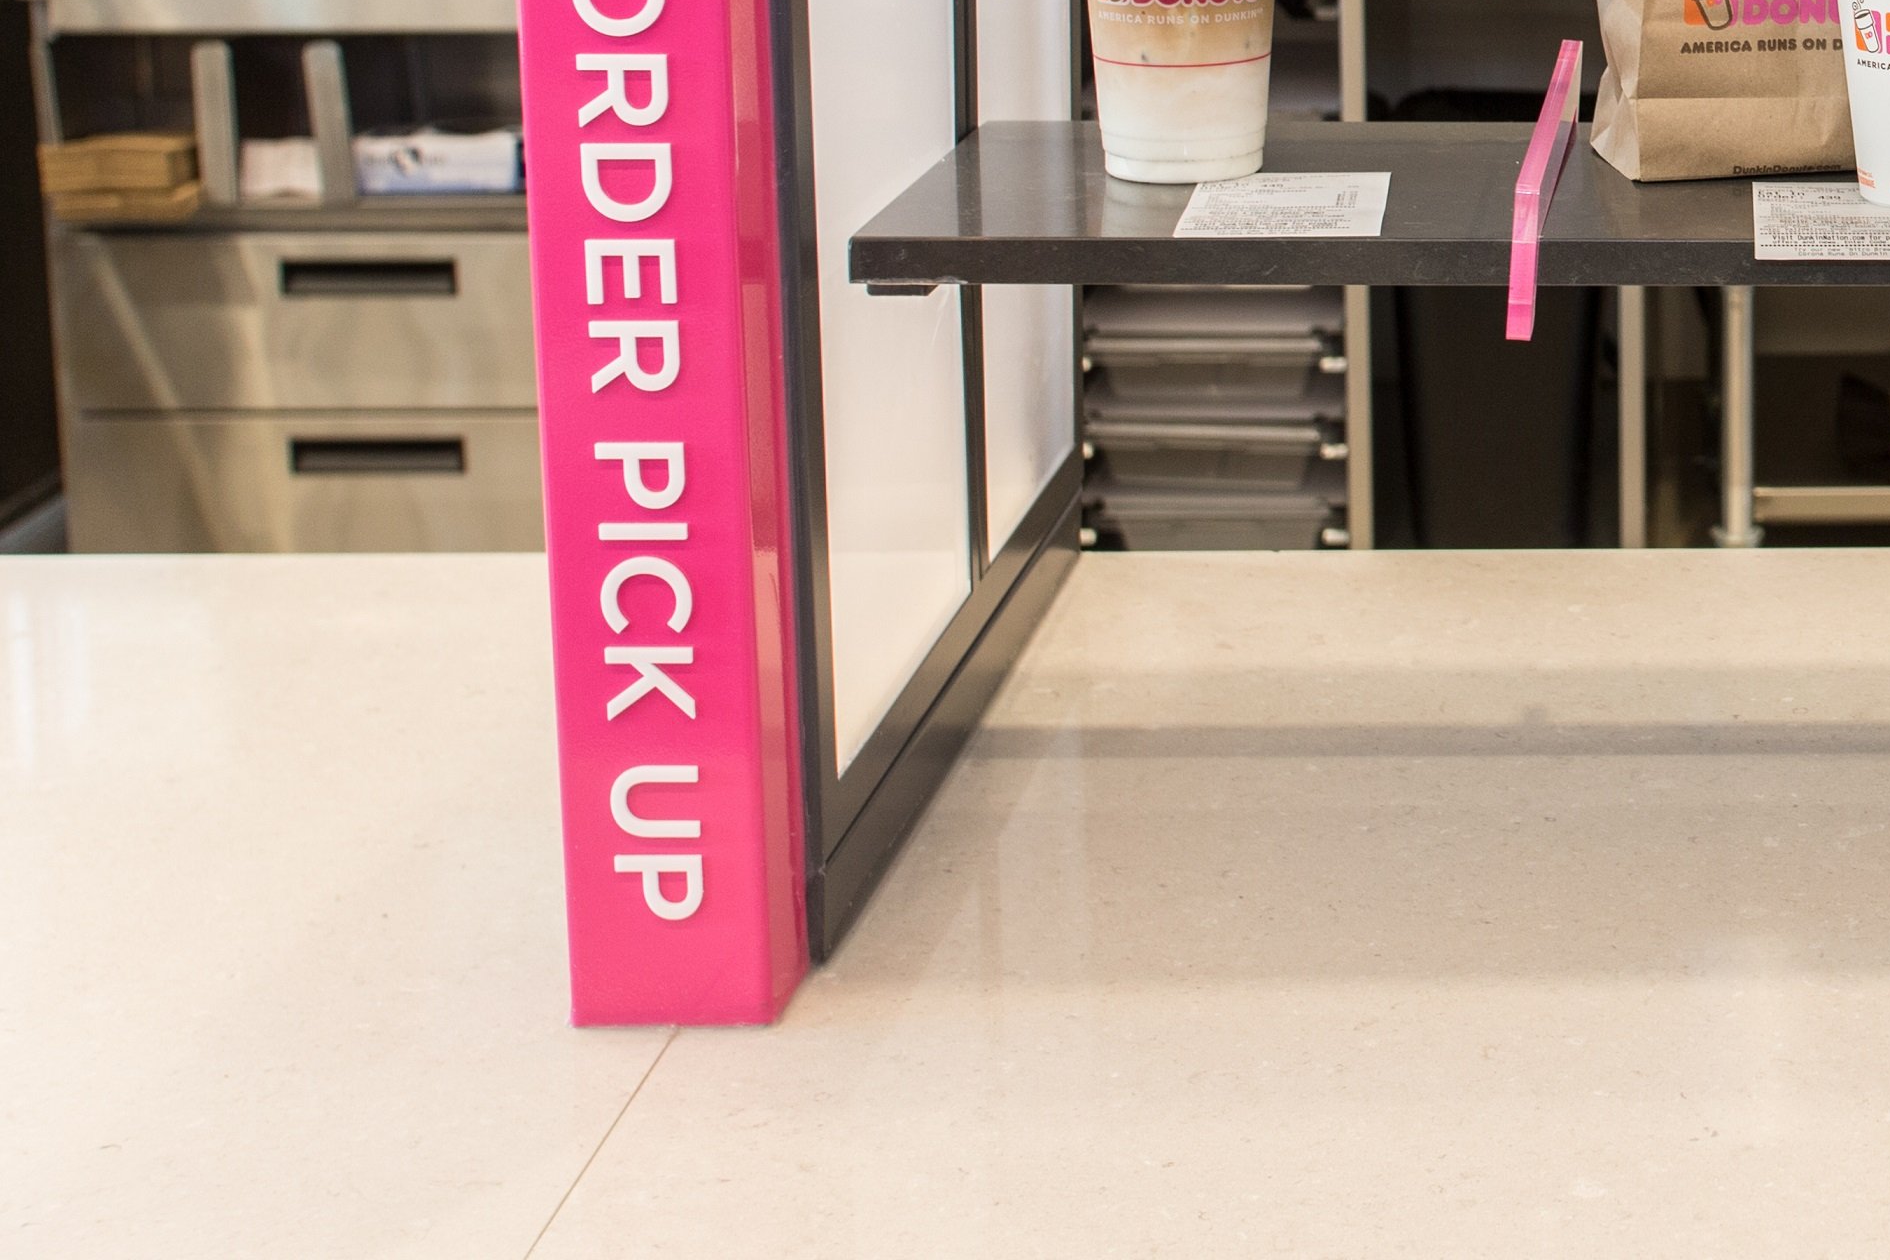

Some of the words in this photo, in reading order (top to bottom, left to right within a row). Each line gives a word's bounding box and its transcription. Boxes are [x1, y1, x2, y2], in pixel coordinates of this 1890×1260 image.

[1098, 11, 1142, 24] AMERICA
[1147, 14, 1184, 25] RUNS
[1190, 14, 1210, 24] ON
[1680, 39, 1752, 55] AMERICA
[1757, 38, 1797, 52] RUNS
[1802, 38, 1827, 51] ON
[595, 442, 695, 720] PICK
[610, 765, 703, 919] UP
